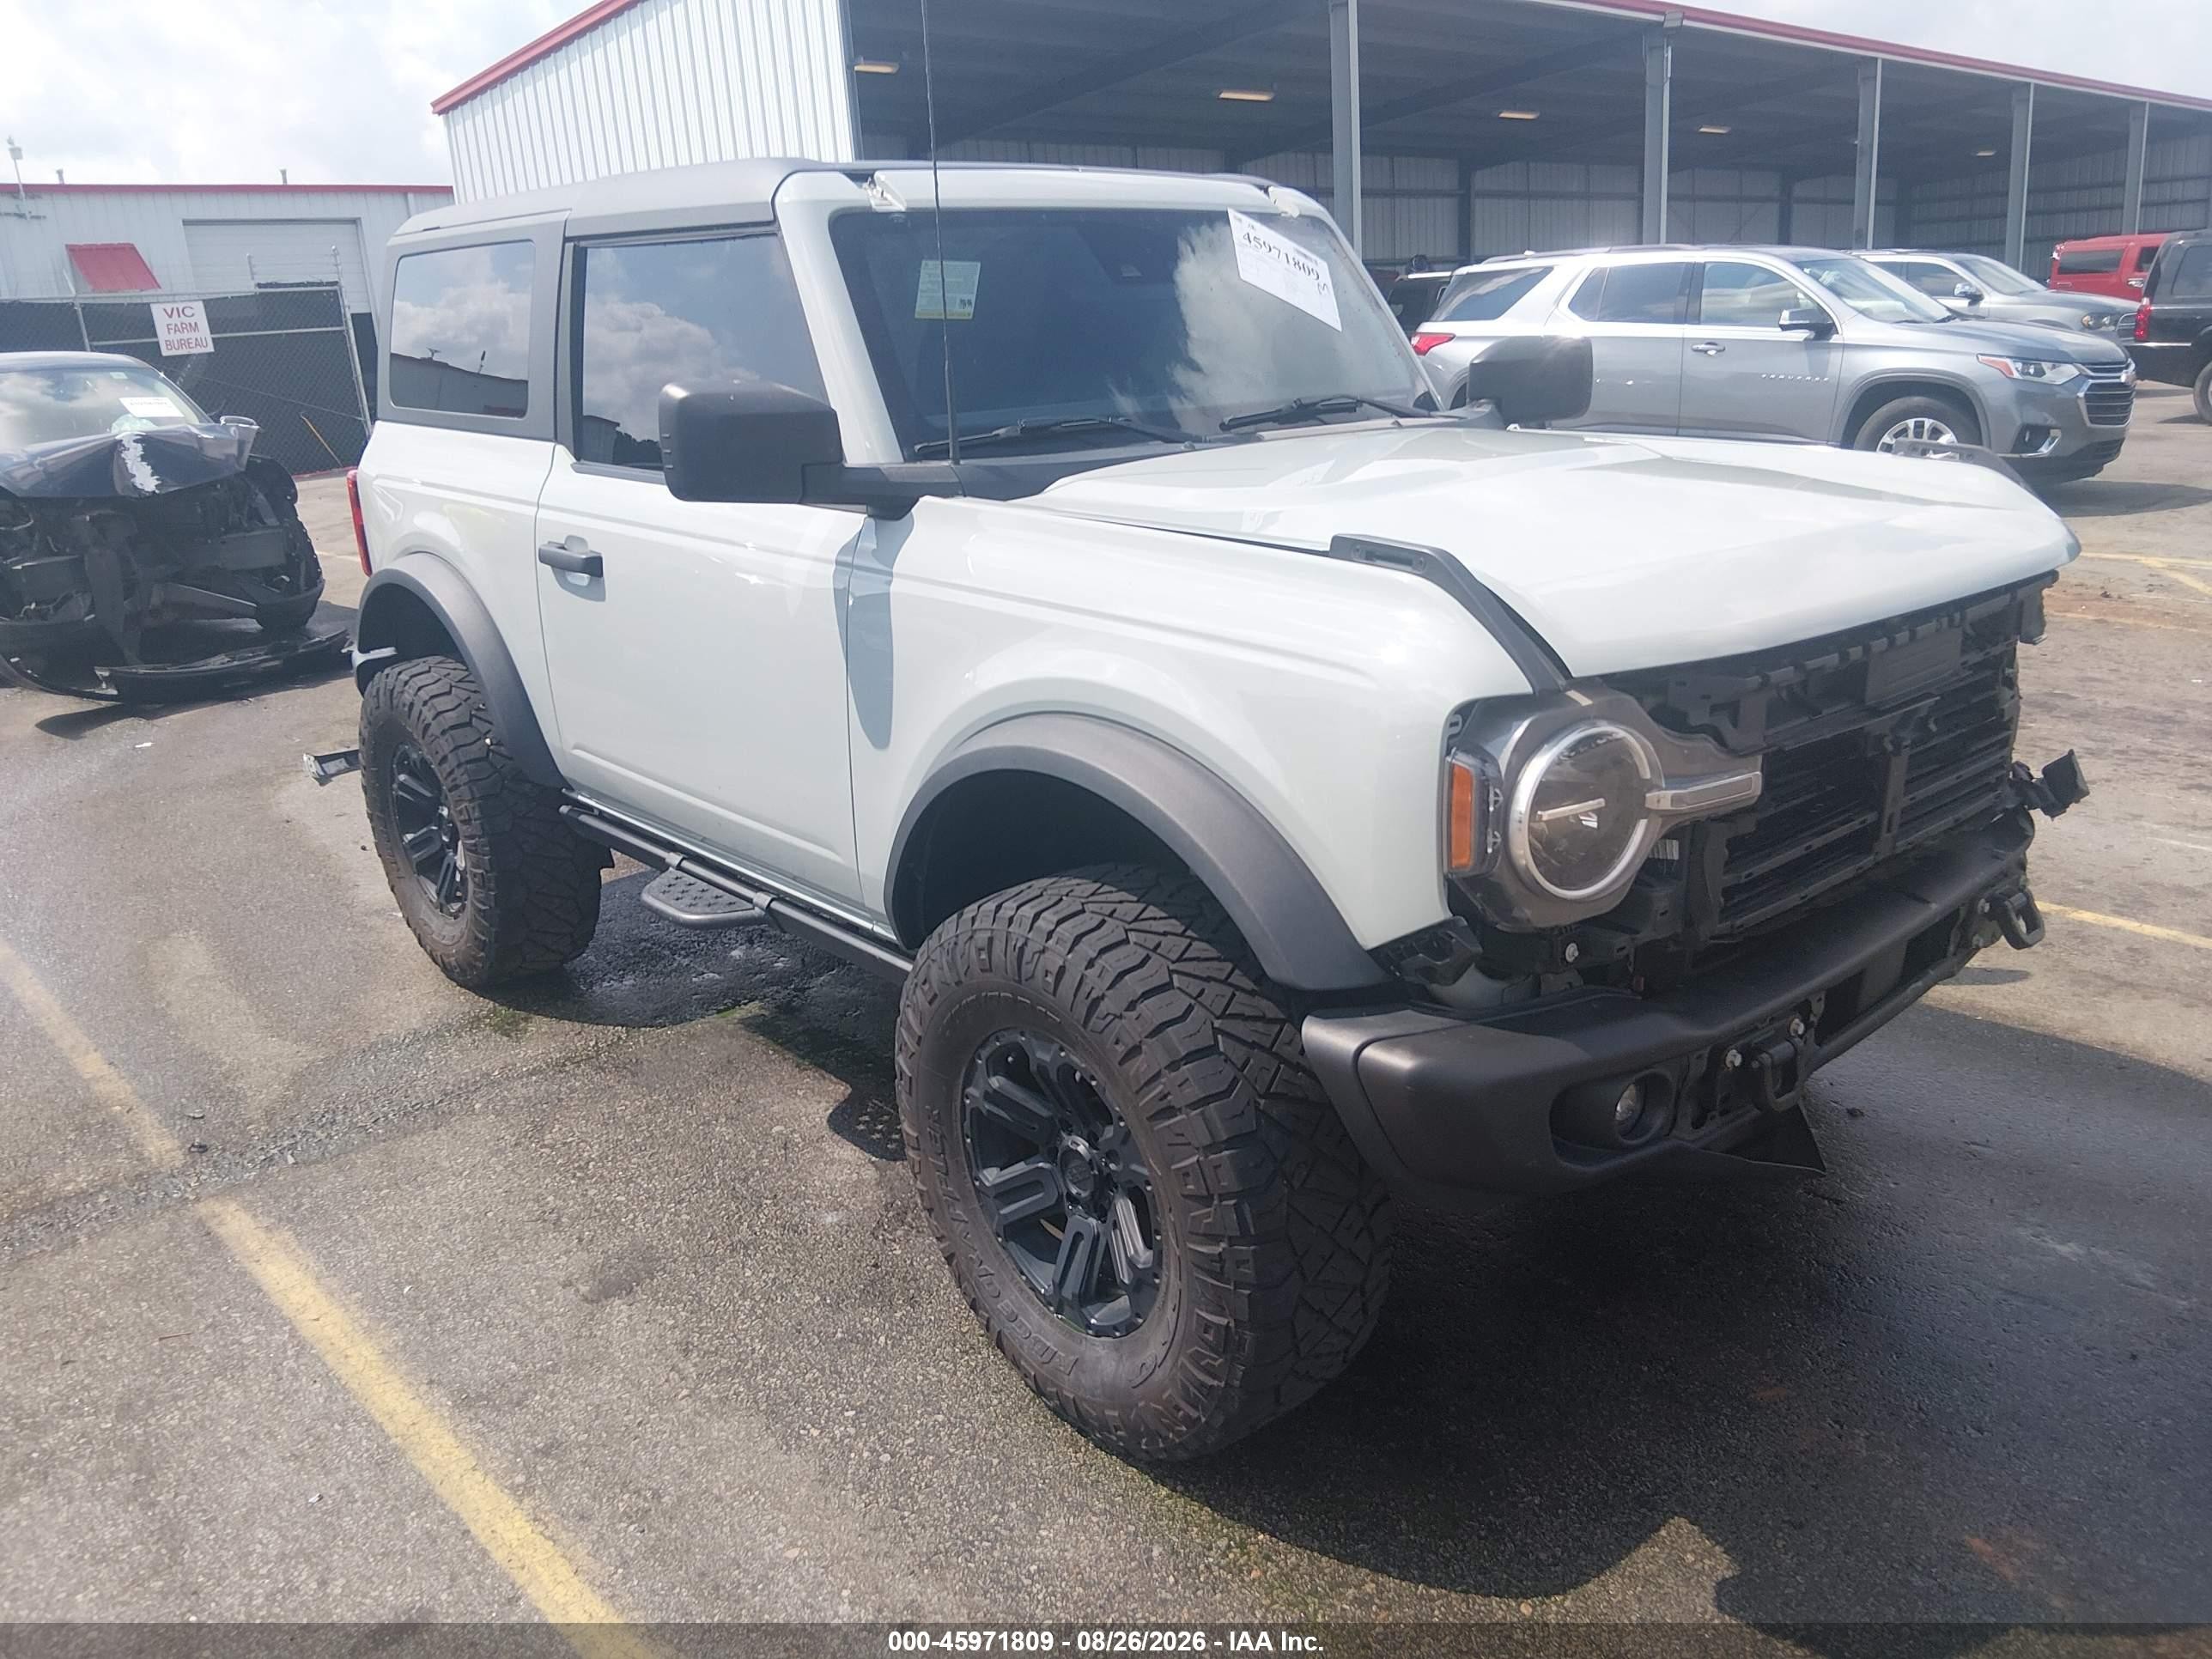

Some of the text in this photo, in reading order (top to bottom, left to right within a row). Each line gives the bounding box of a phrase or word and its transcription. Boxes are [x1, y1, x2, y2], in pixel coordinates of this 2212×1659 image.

[1243, 232, 1320, 281] 45971809
[162, 306, 195, 319] VIC
[166, 321, 200, 335] FARM
[164, 336, 209, 351] BUREAU
